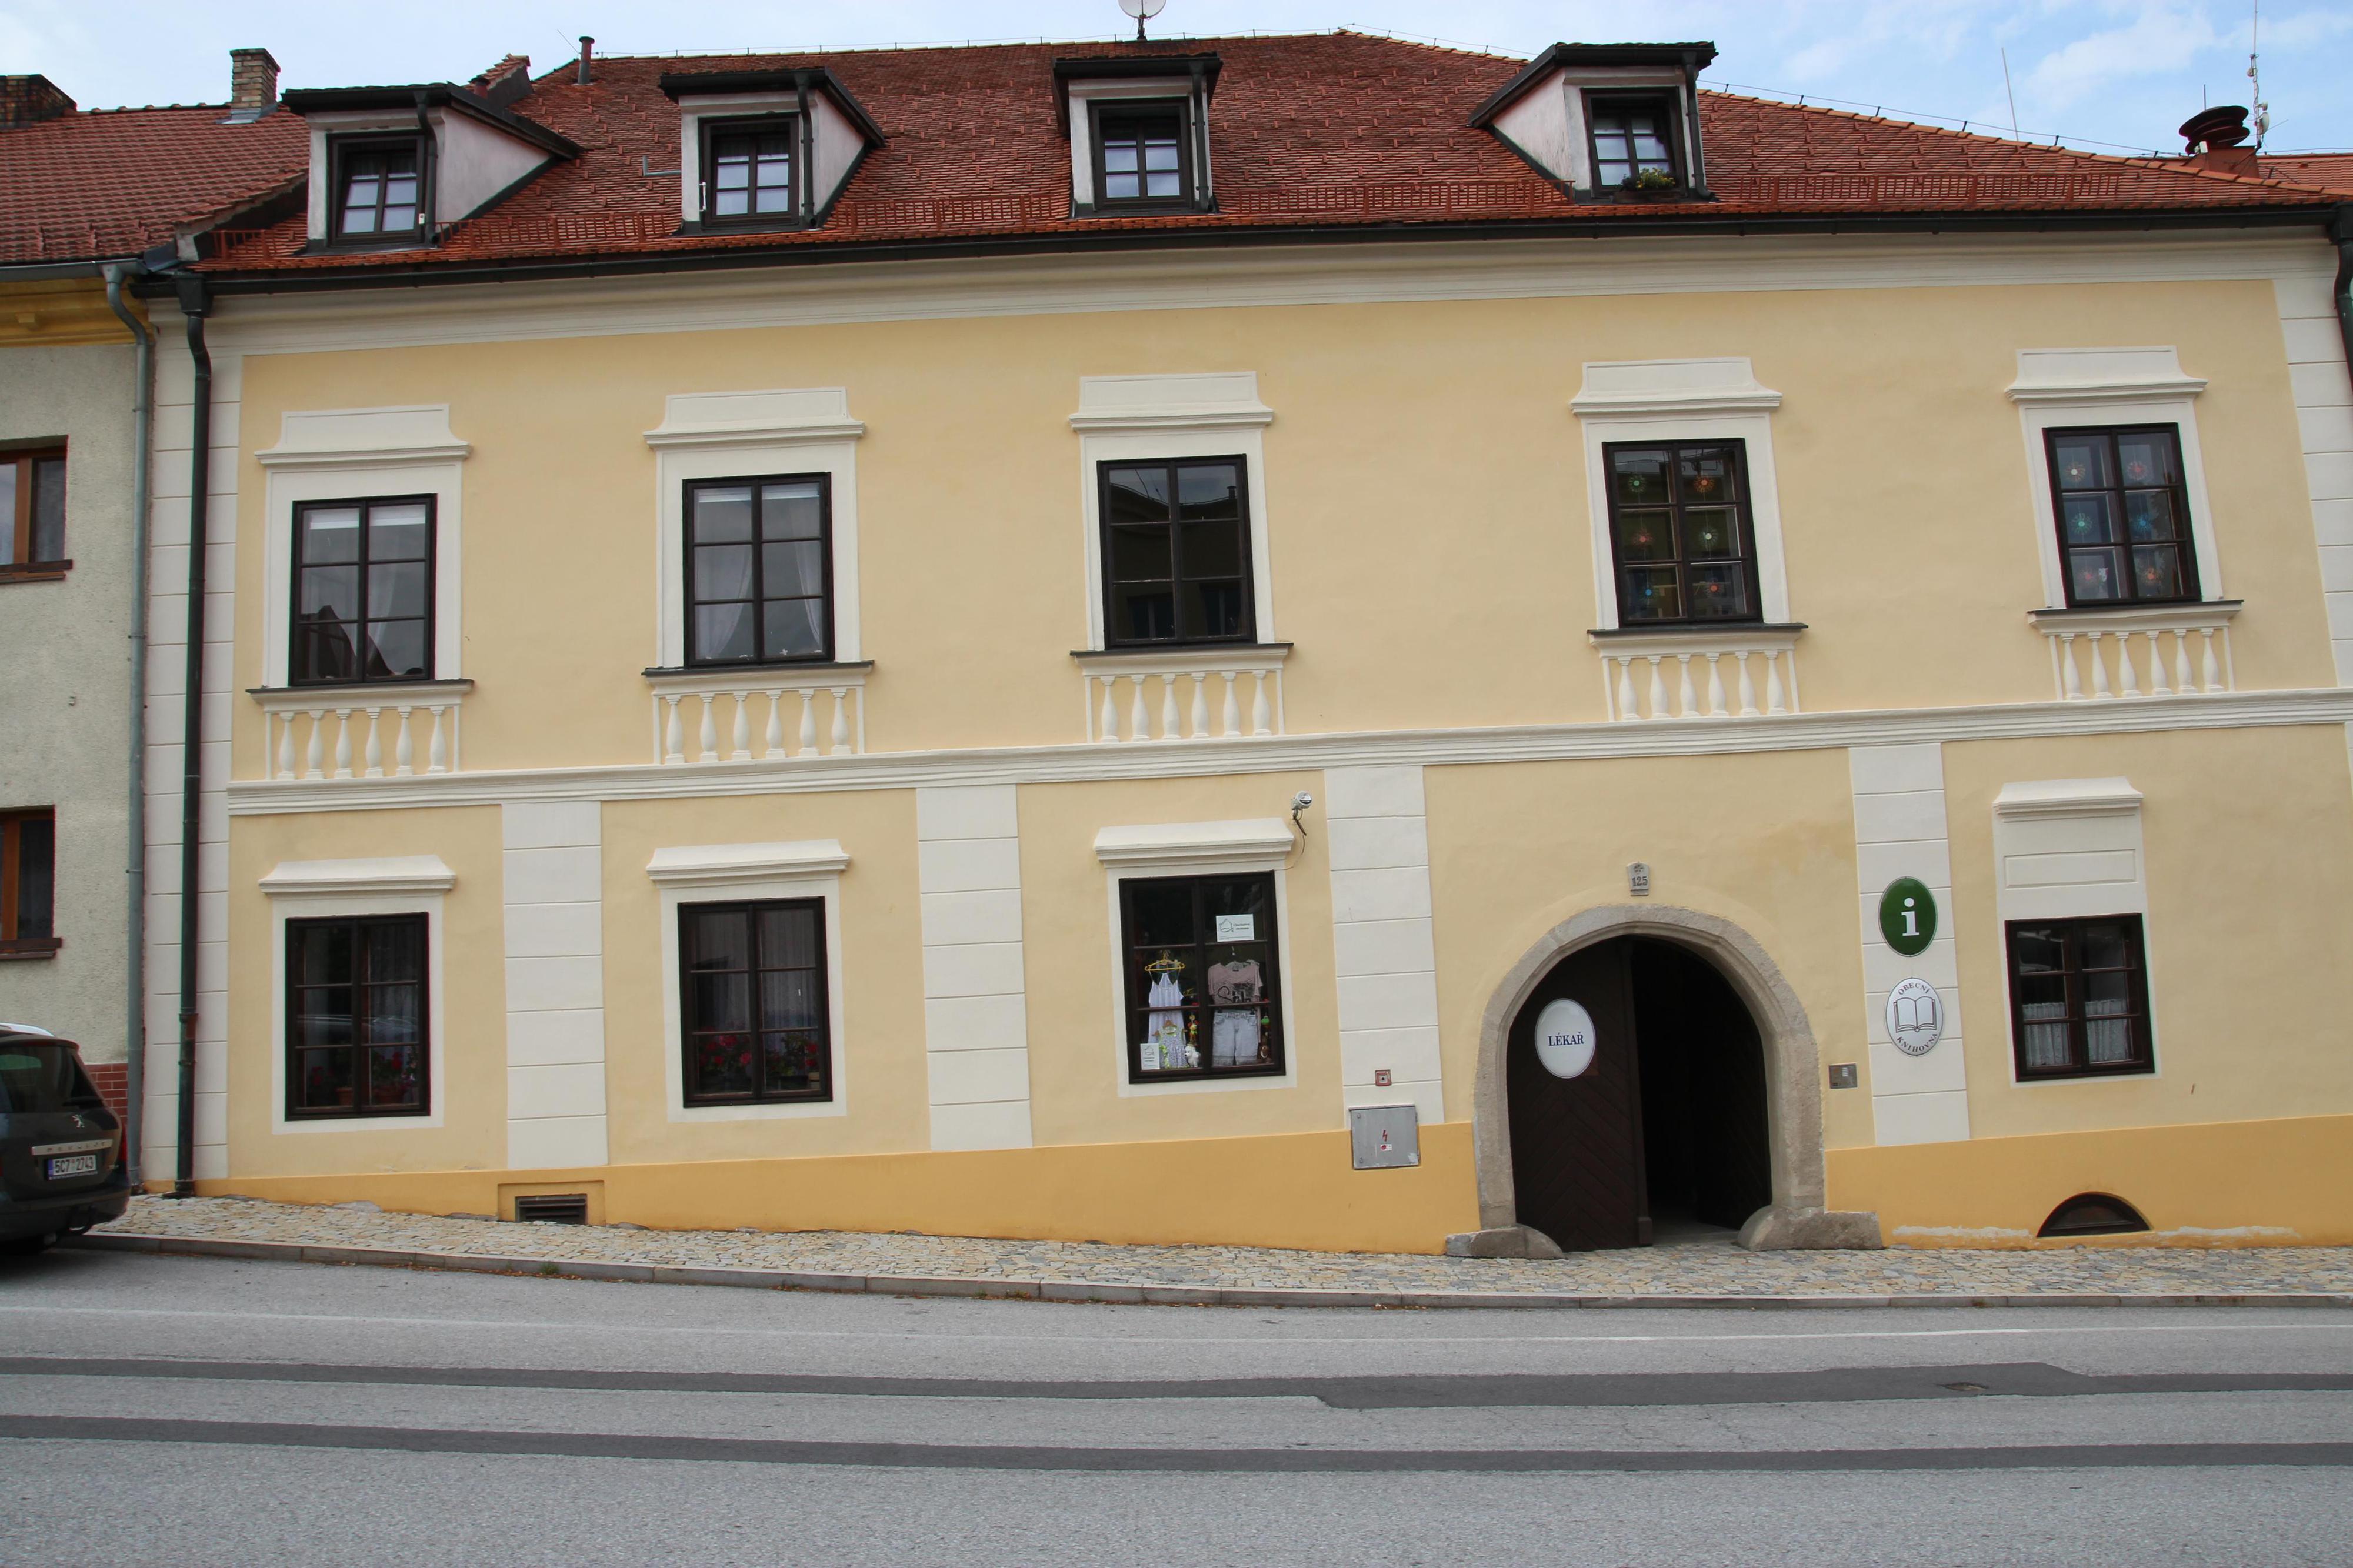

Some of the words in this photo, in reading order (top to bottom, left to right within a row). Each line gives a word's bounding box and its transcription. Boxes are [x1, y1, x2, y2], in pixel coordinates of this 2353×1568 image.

[1632, 876, 1648, 887] 125
[1898, 982, 1930, 995] OBECNÍ
[1548, 1031, 1584, 1046] LÉKAŘ
[1897, 1033, 1938, 1052] KNIHOVNA
[55, 1159, 70, 1173] 5C7
[76, 1157, 94, 1171] 2743
